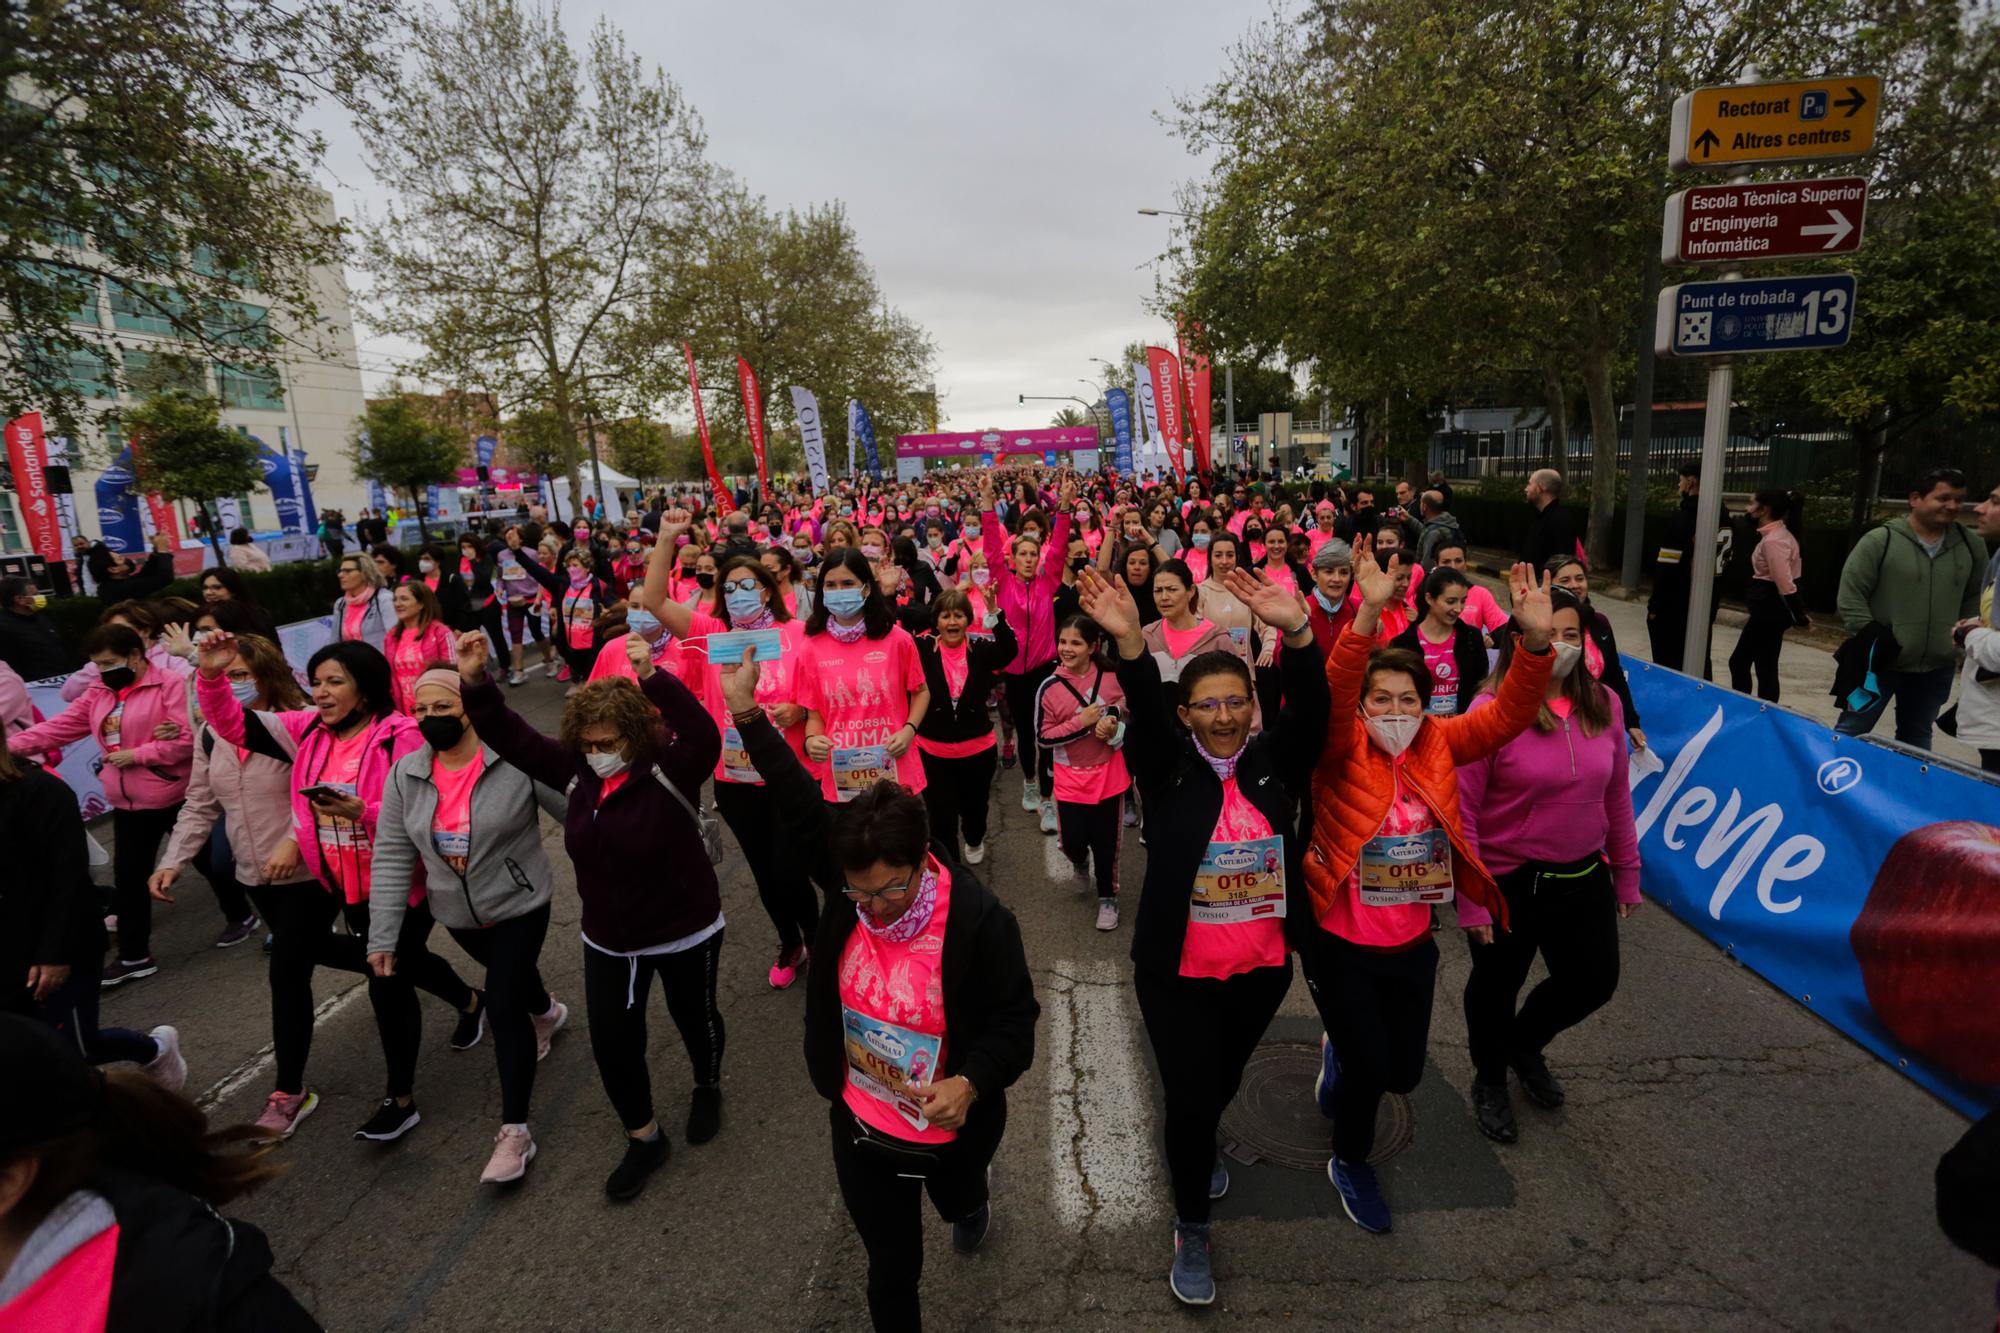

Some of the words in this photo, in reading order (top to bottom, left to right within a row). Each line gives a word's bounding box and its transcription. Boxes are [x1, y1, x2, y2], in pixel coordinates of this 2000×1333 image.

[1718, 98, 1790, 118] Rectorat
[1732, 132, 1783, 150] Altres
[1787, 129, 1851, 146] centres
[1691, 193, 1738, 211] Escola
[1742, 189, 1797, 207] Tècnica
[1800, 185, 1863, 204] Superior
[1687, 236, 1769, 256] Informàtica
[1681, 294, 1714, 309] Punt
[1717, 293, 1736, 308] de
[1738, 290, 1796, 307] trobada
[1800, 288, 1847, 336] 13
[22, 427, 46, 498] Santander
[848, 717, 895, 731] DORSAL
[831, 727, 892, 750] SUMA
[852, 768, 878, 780] 016
[1630, 704, 1826, 920] lene
[1216, 855, 1256, 866] ASTURIANA
[1390, 847, 1426, 857] ASTURIANA
[1389, 863, 1427, 878] 016
[1217, 872, 1257, 889] 016
[1209, 900, 1233, 908] CARRERA
[1228, 891, 1248, 899] 3182
[1368, 895, 1398, 903] OYSHO
[1198, 911, 1229, 919] OYSHO
[866, 1033, 902, 1057] ASTURIANA
